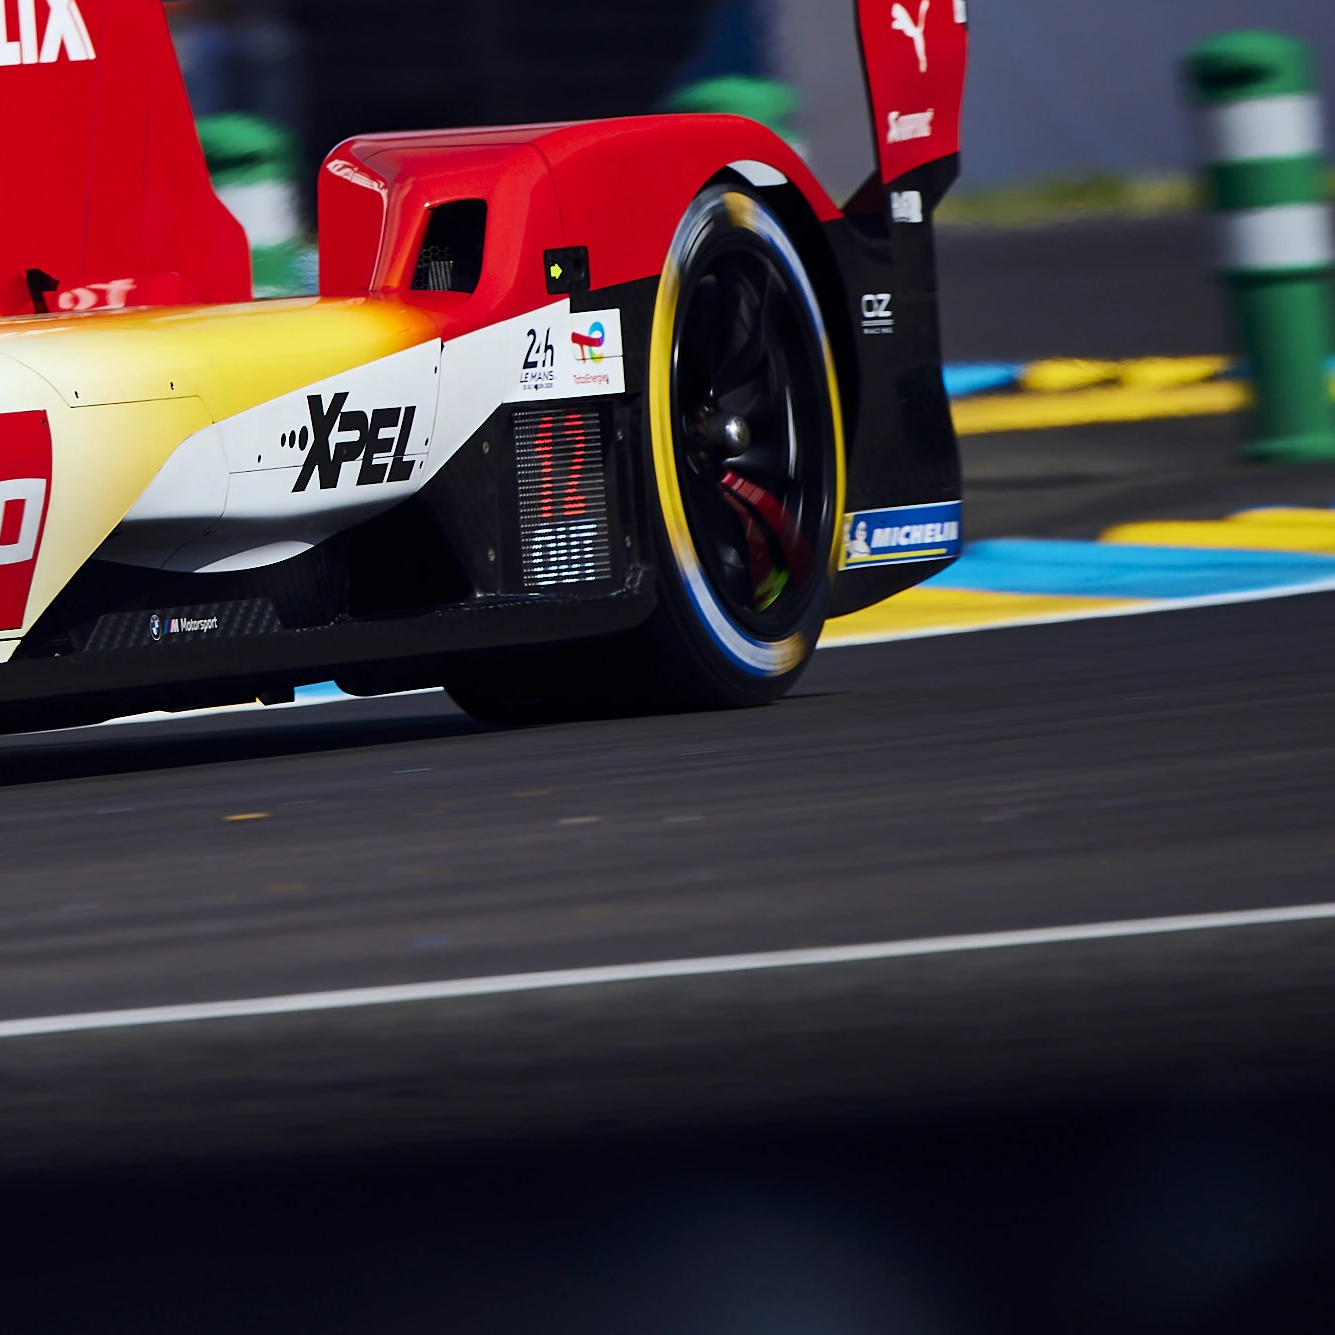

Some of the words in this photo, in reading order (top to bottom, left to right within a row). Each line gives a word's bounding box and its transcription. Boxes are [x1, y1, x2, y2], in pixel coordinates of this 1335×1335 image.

[861, 293, 892, 318] OZ
[522, 326, 554, 369] 24h
[520, 372, 530, 383] LE
[531, 370, 554, 382] MANS
[291, 391, 417, 493] XPEL
[180, 616, 218, 633] Motorsport
